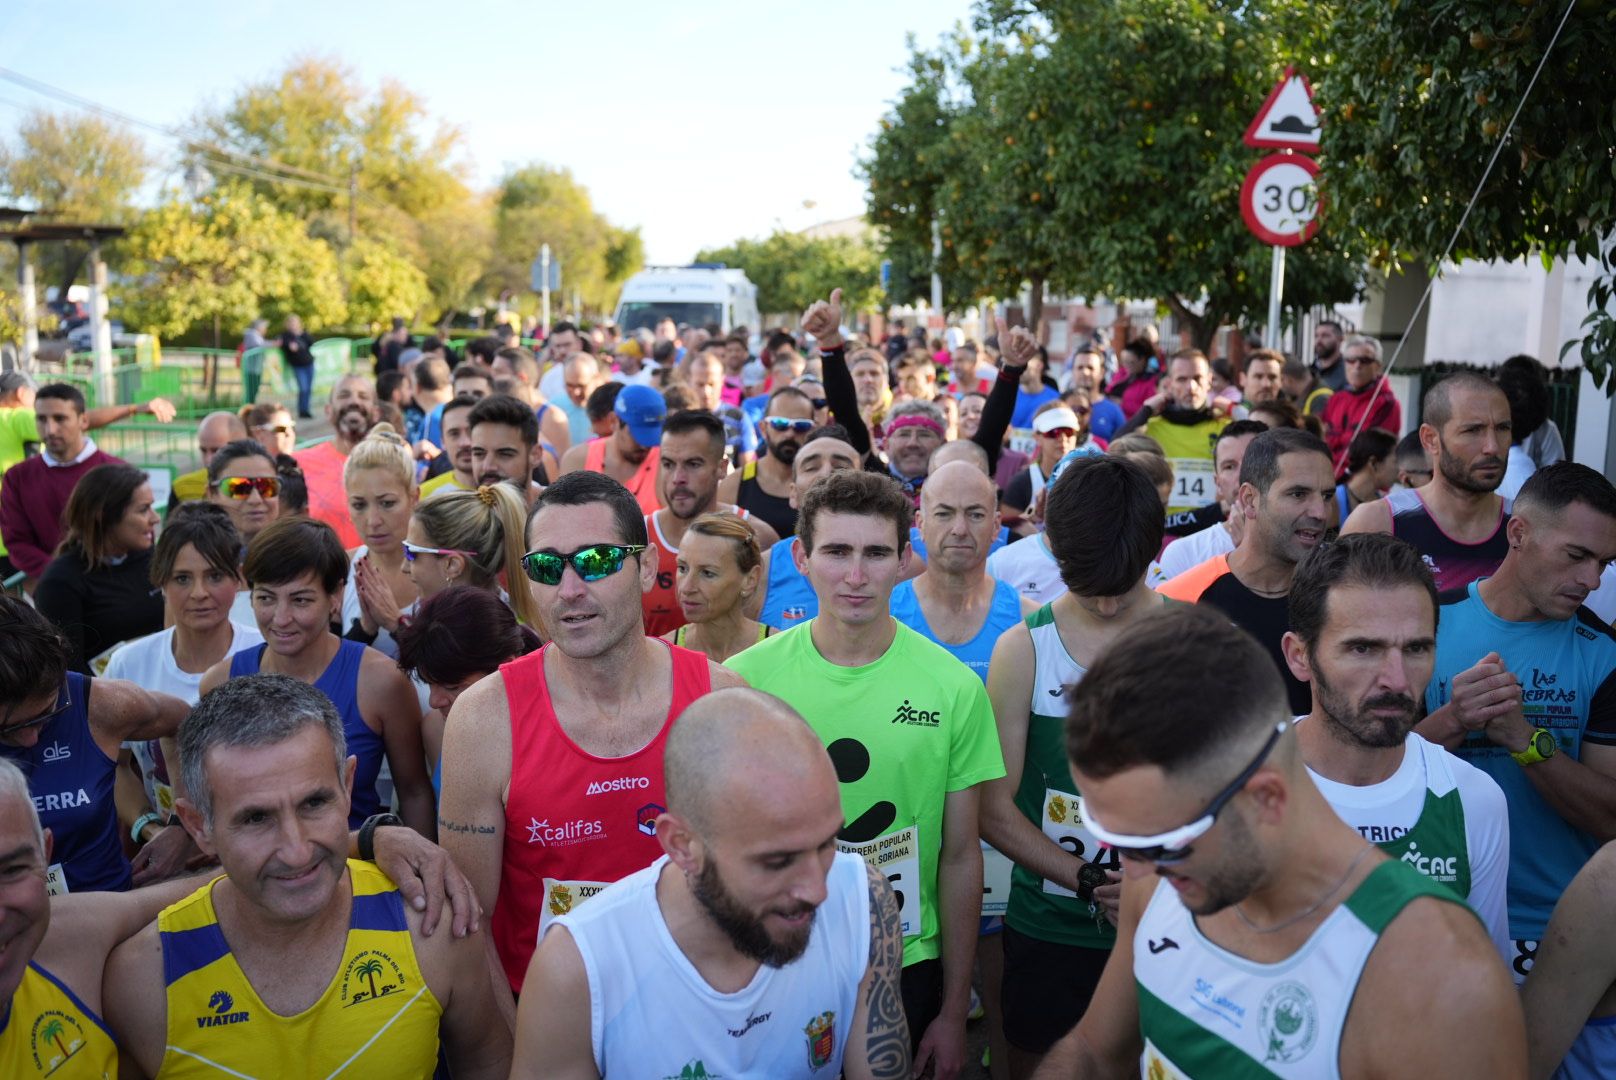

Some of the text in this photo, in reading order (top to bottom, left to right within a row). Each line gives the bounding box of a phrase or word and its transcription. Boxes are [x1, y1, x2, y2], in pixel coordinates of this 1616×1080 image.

[1263, 185, 1309, 213] 30
[1177, 477, 1205, 496] 14
[1532, 668, 1557, 689] LAS
[907, 710, 941, 723] CAC
[43, 740, 71, 762] als
[544, 820, 602, 842] califas
[880, 831, 911, 850] POPULAR
[1358, 825, 1410, 841] TRIC
[878, 846, 909, 864] SORIANA
[1417, 857, 1457, 875] CAC
[371, 950, 391, 962] PALMA
[390, 961, 400, 974] DEL
[1513, 939, 1540, 976] 8
[196, 1011, 249, 1029] VIATOR
